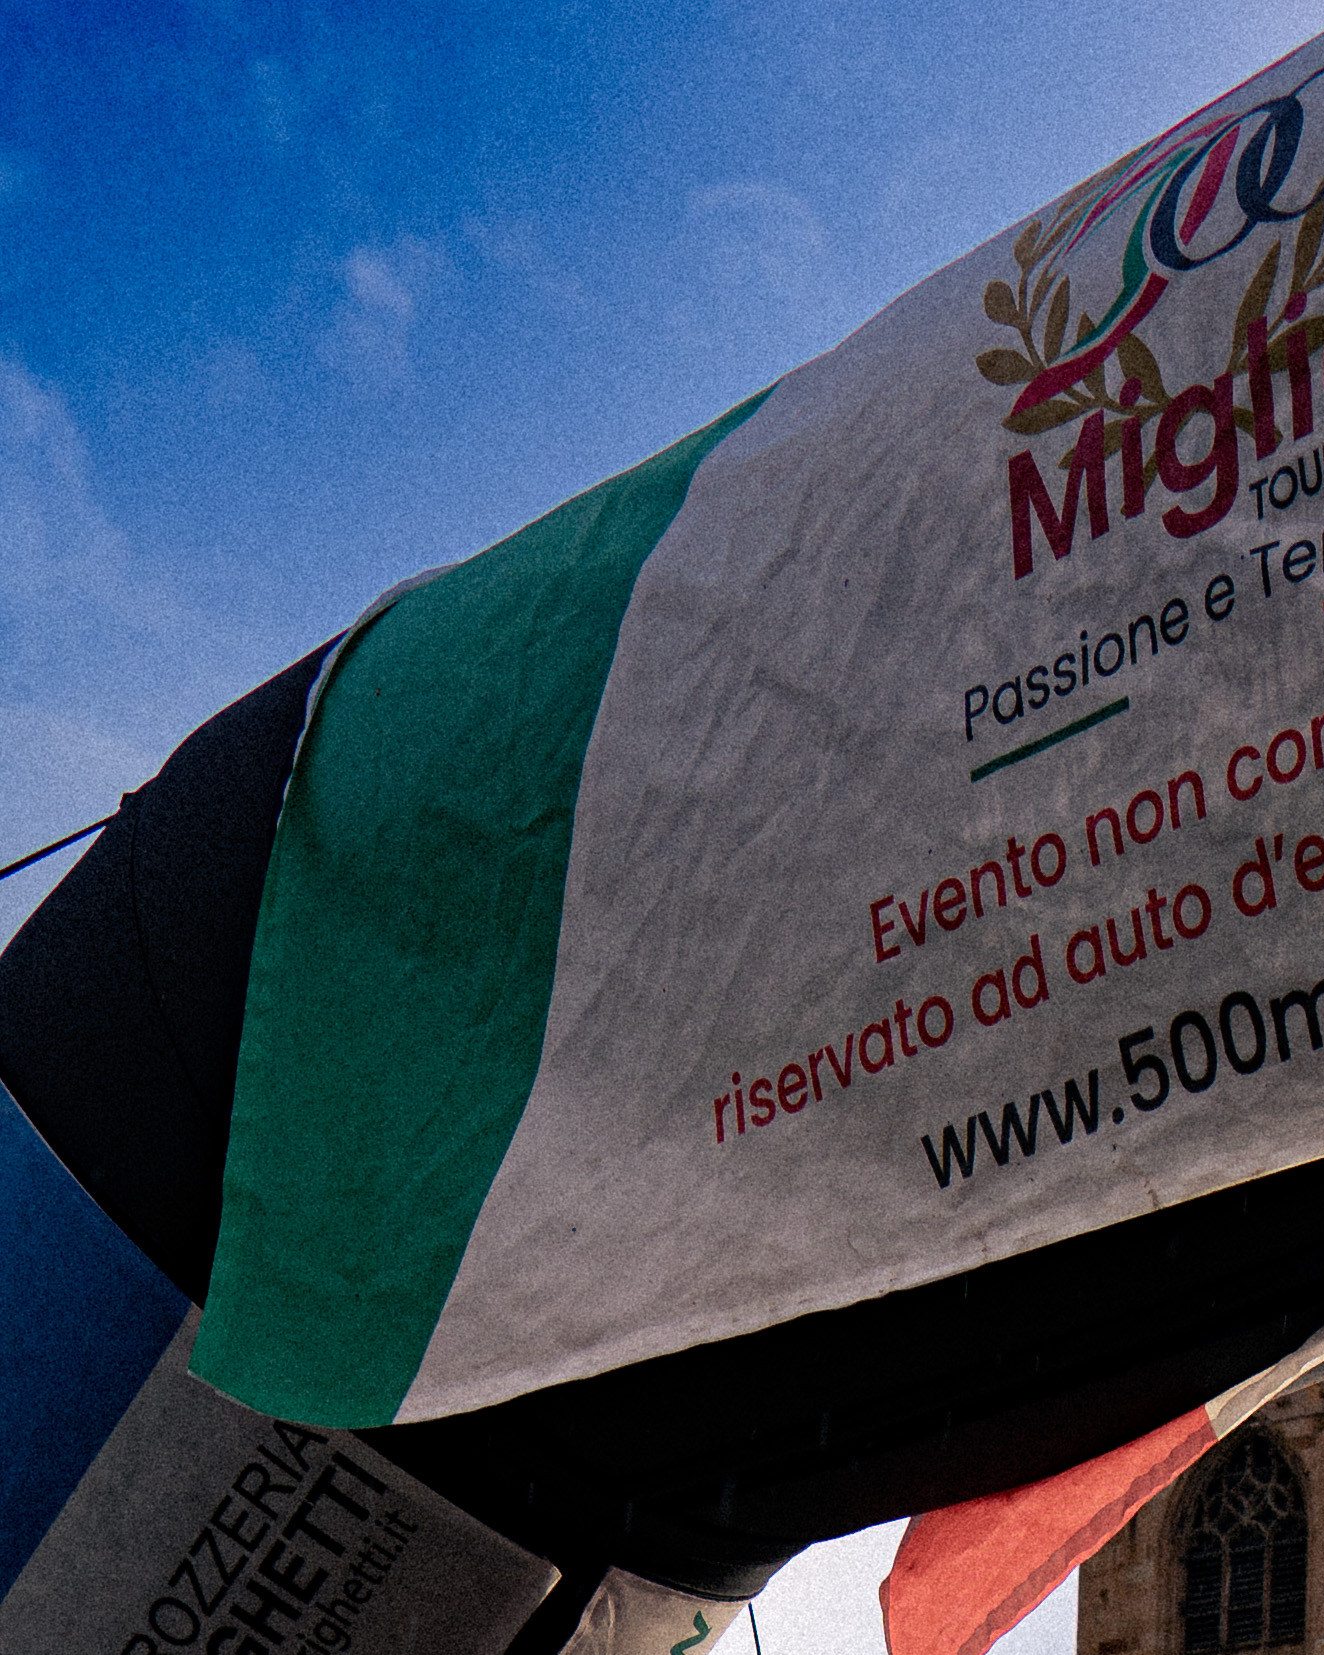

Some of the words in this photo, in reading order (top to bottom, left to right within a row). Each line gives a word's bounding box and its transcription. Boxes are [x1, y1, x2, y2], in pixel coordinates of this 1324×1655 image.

[962, 610, 1190, 742] Passione
[1204, 572, 1236, 620] e
[869, 826, 1066, 963] Evento
[1084, 772, 1207, 878] non
[712, 984, 956, 1143] riservato
[972, 936, 1050, 1026] ad
[1067, 884, 1213, 988] auto
